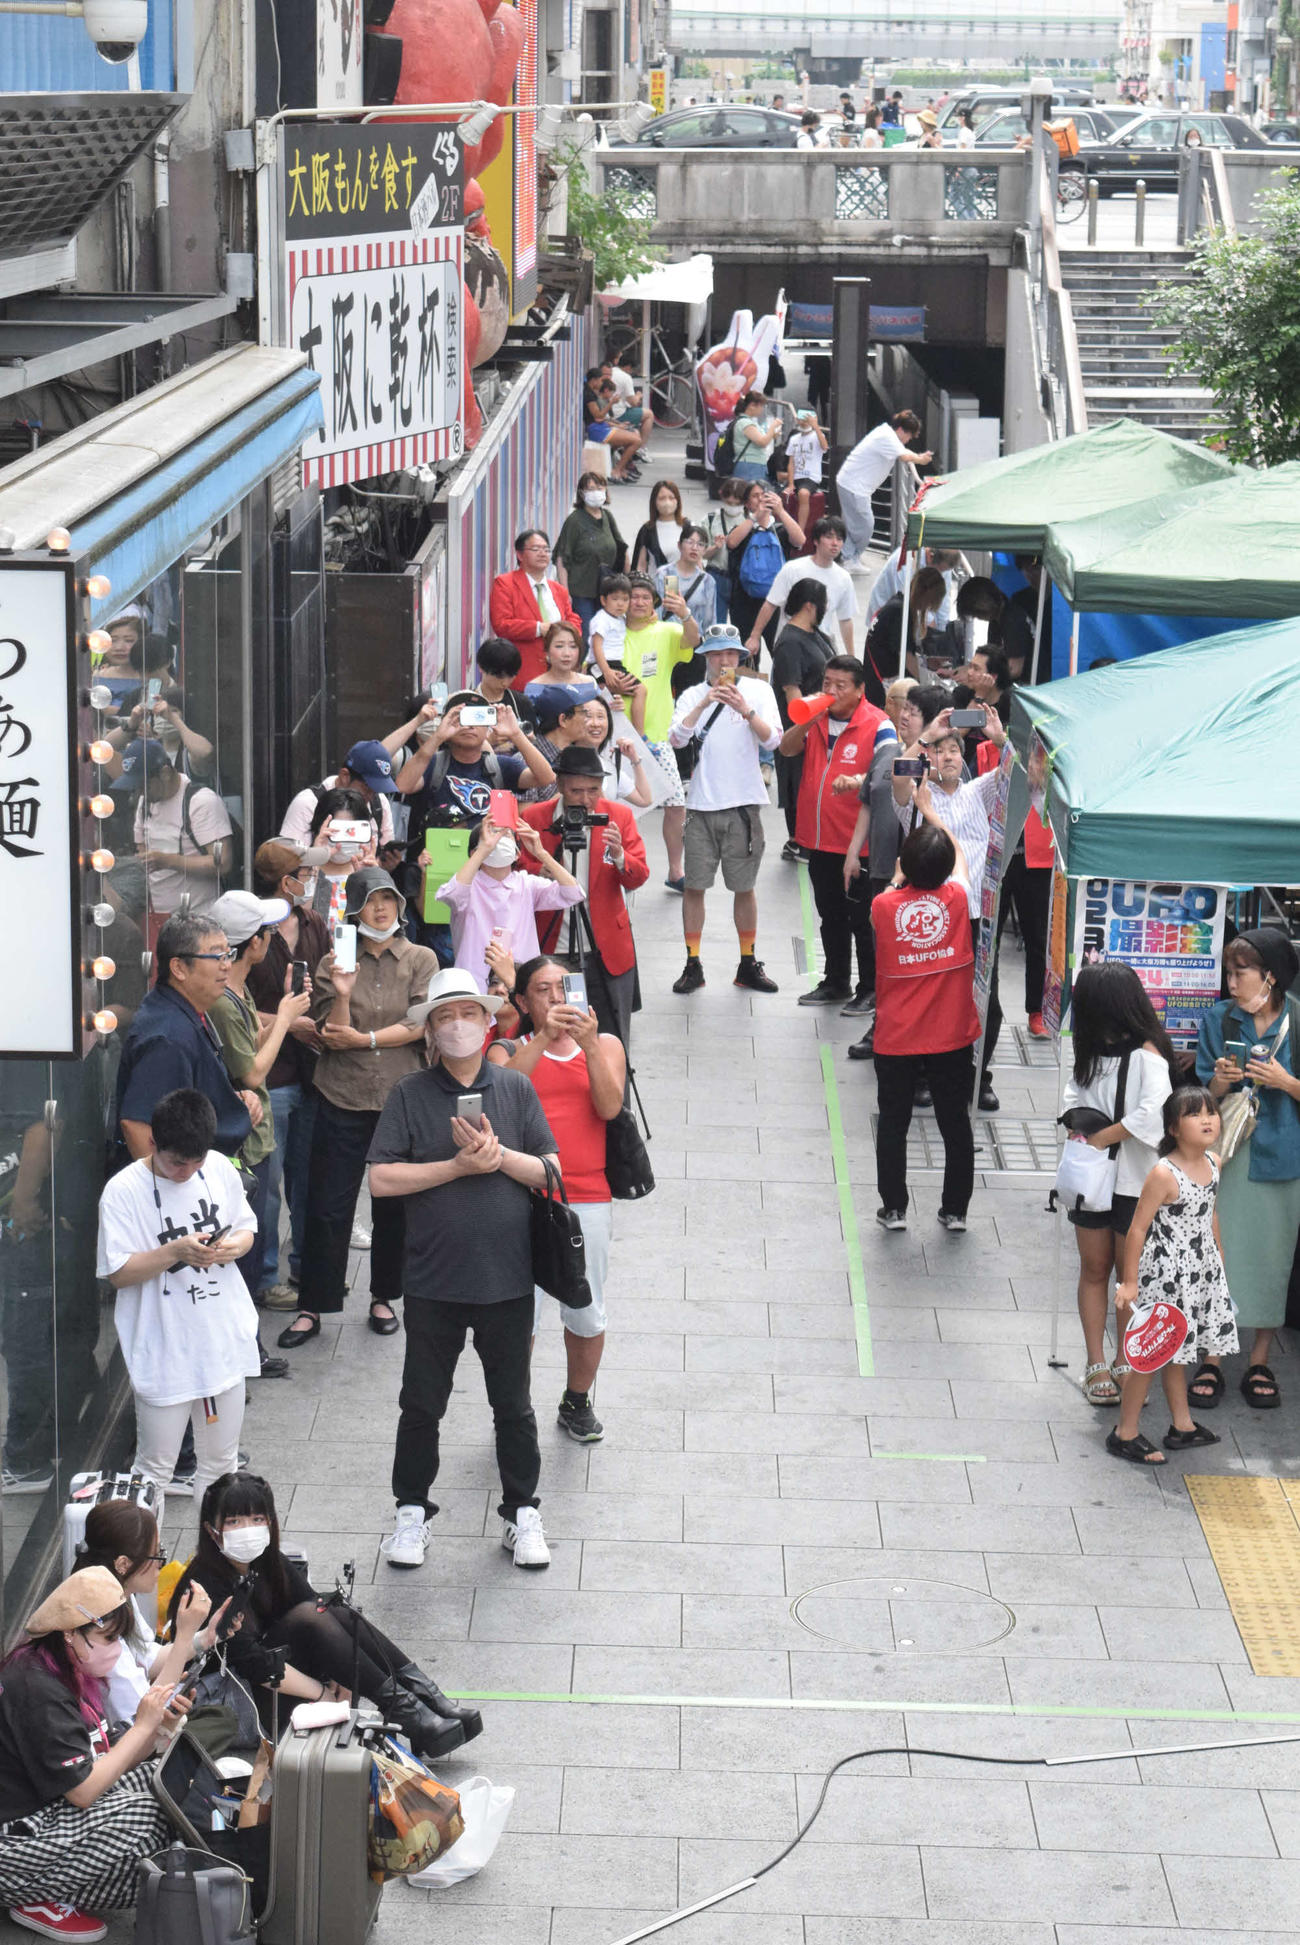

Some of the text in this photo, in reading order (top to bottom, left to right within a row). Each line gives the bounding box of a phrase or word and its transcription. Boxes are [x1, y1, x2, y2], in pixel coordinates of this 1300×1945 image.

[288, 142, 418, 217] 大阪もんを食す
[441, 185, 460, 222] 2F
[300, 272, 440, 443] 大阪に乾杯
[1112, 882, 1218, 920] UFO
[187, 1281, 220, 1305] たこ
